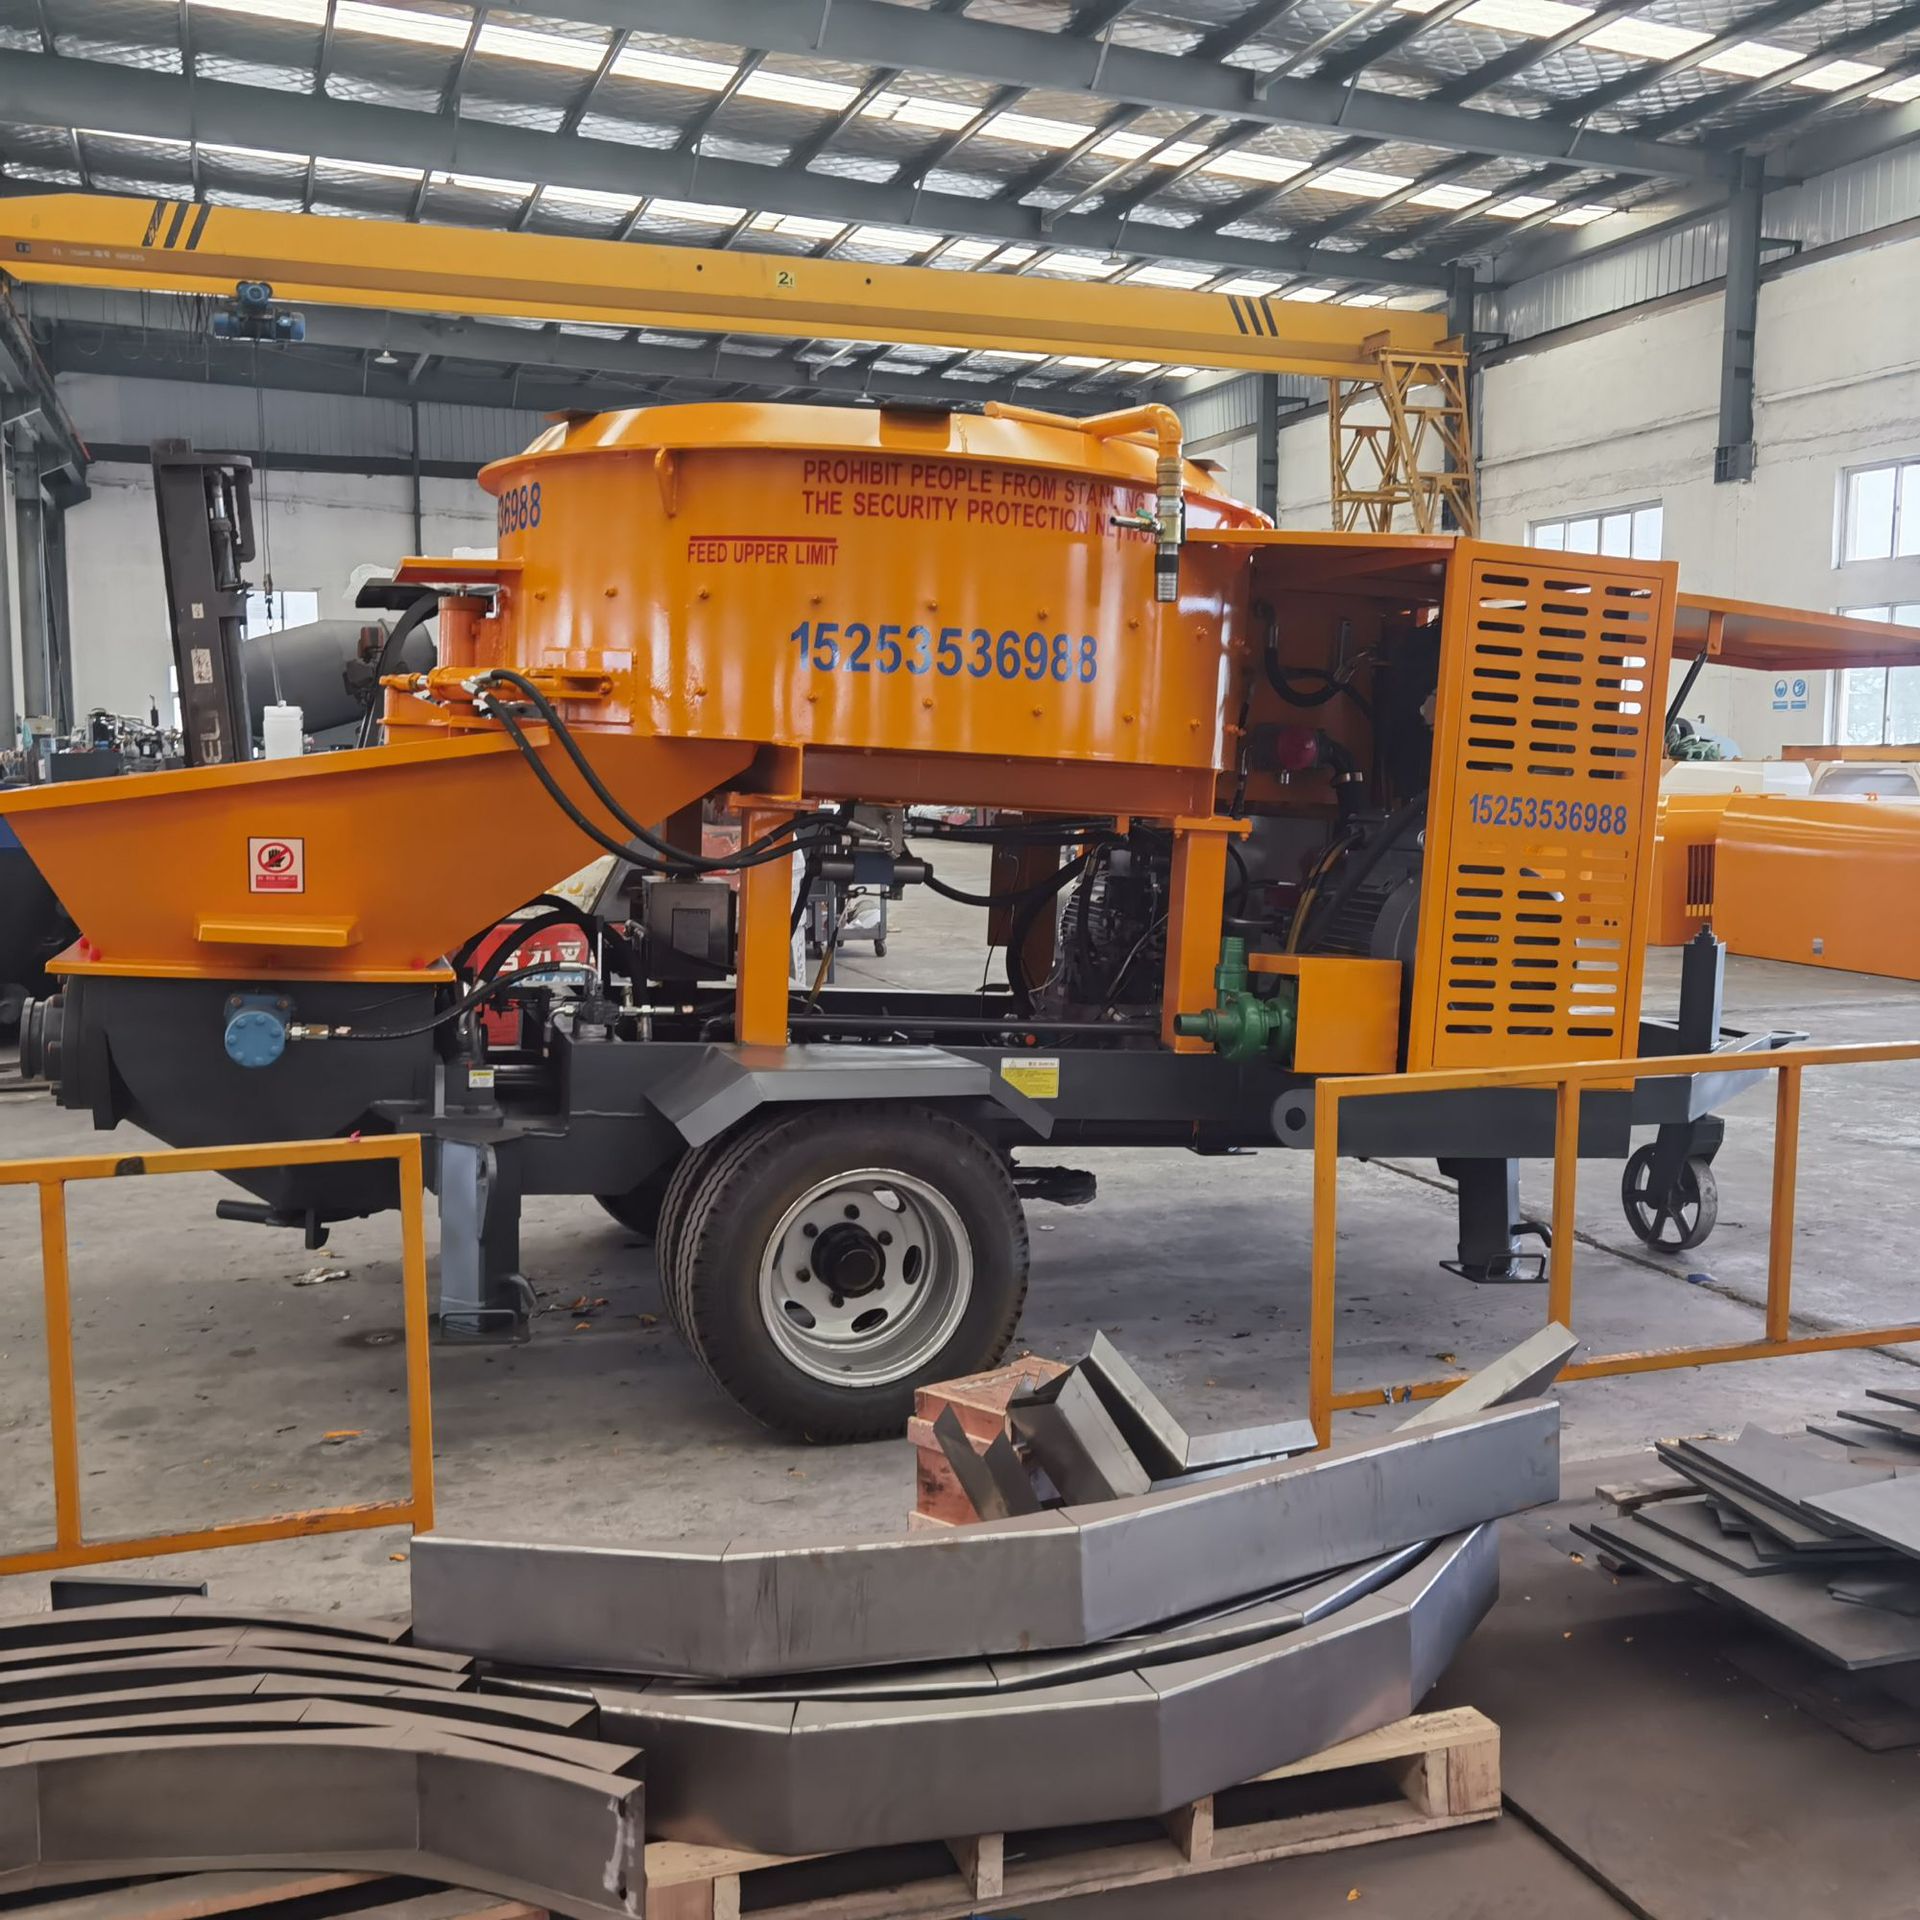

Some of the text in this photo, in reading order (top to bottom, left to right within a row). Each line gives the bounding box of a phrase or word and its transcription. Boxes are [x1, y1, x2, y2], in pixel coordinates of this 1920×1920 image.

[803, 459, 1145, 513] PROHIBIT PEOPLE FROM STANNG
[802, 490, 843, 515] THE
[853, 492, 958, 521] SECURITY
[967, 499, 1089, 534] PROTECTION
[687, 542, 839, 566] FEED UPPER LIMIT
[790, 620, 1098, 684] 15253536988
[1469, 793, 1627, 835] 15253536988
